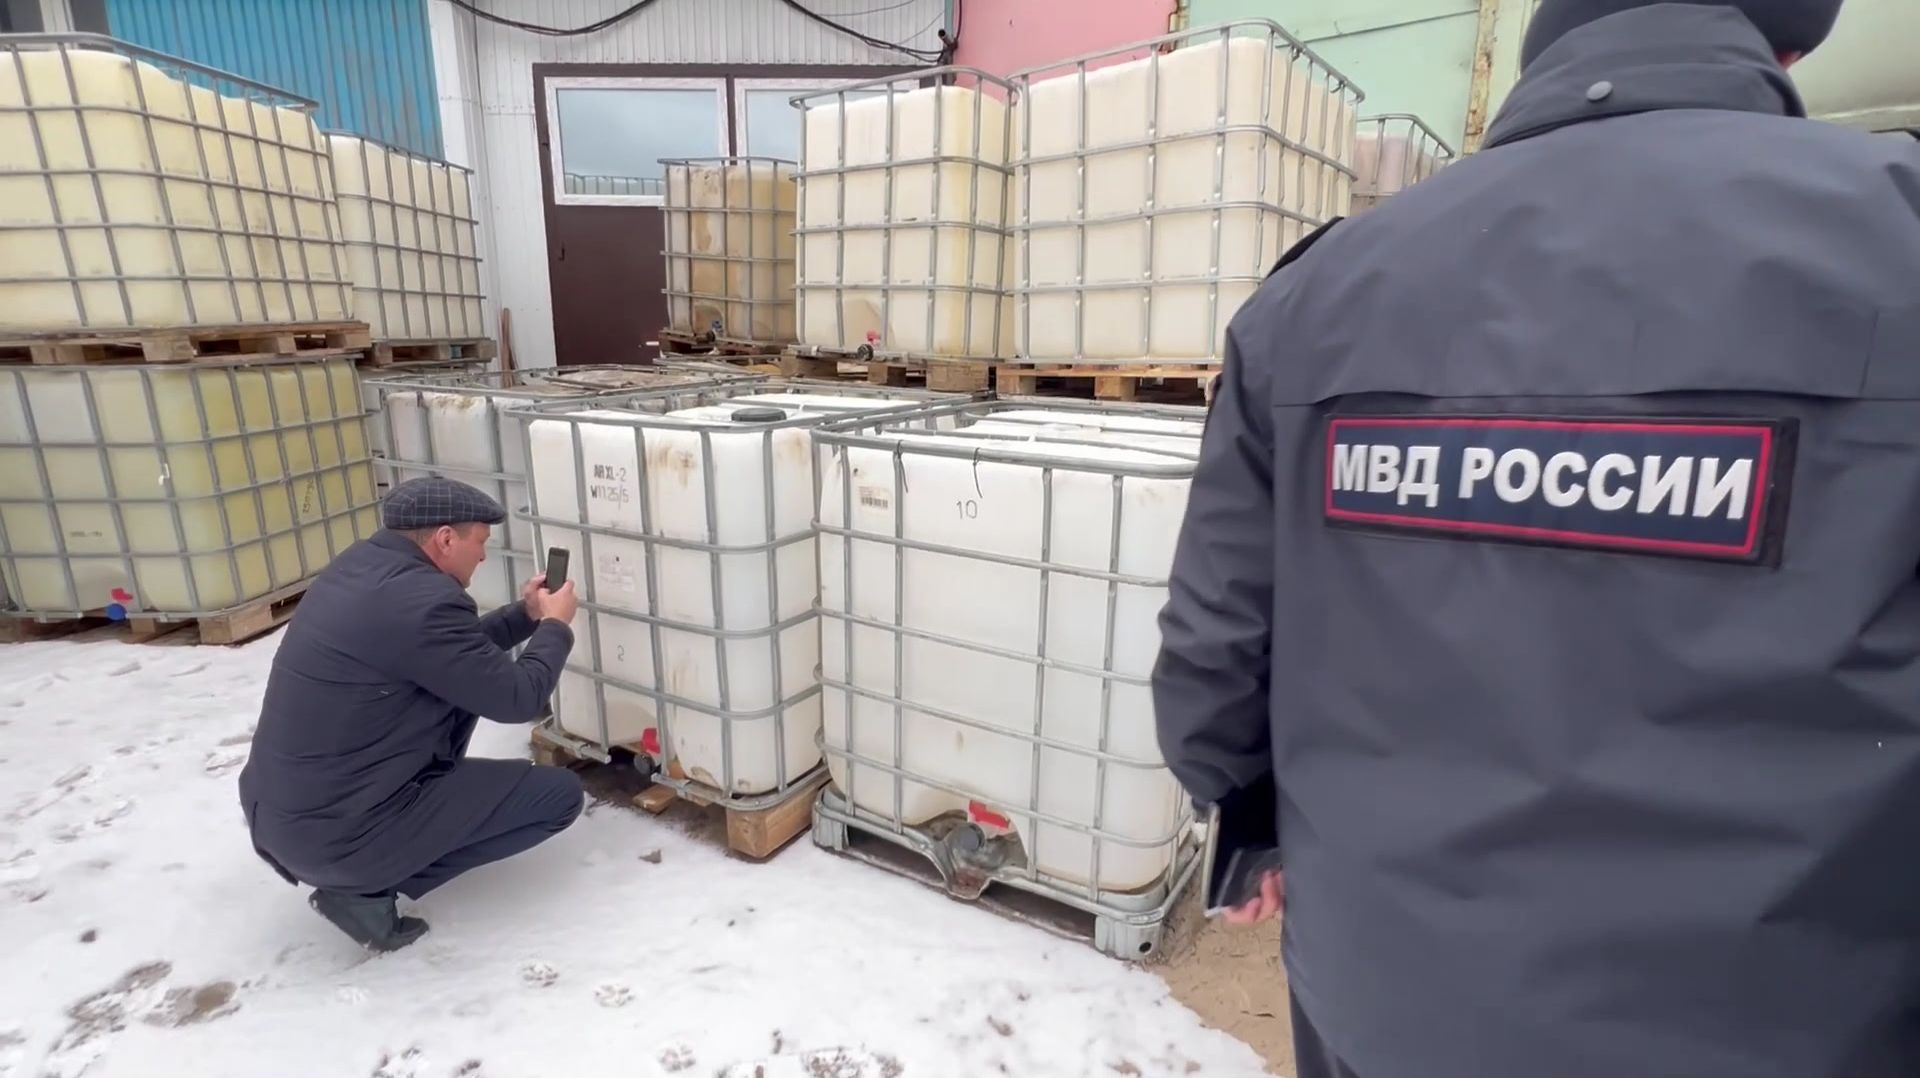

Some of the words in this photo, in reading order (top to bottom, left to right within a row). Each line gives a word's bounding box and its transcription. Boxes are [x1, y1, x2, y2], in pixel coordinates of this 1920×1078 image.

[1332, 444, 1441, 508] МВД
[1458, 447, 1754, 520] РОССИИ
[956, 499, 978, 519] 10
